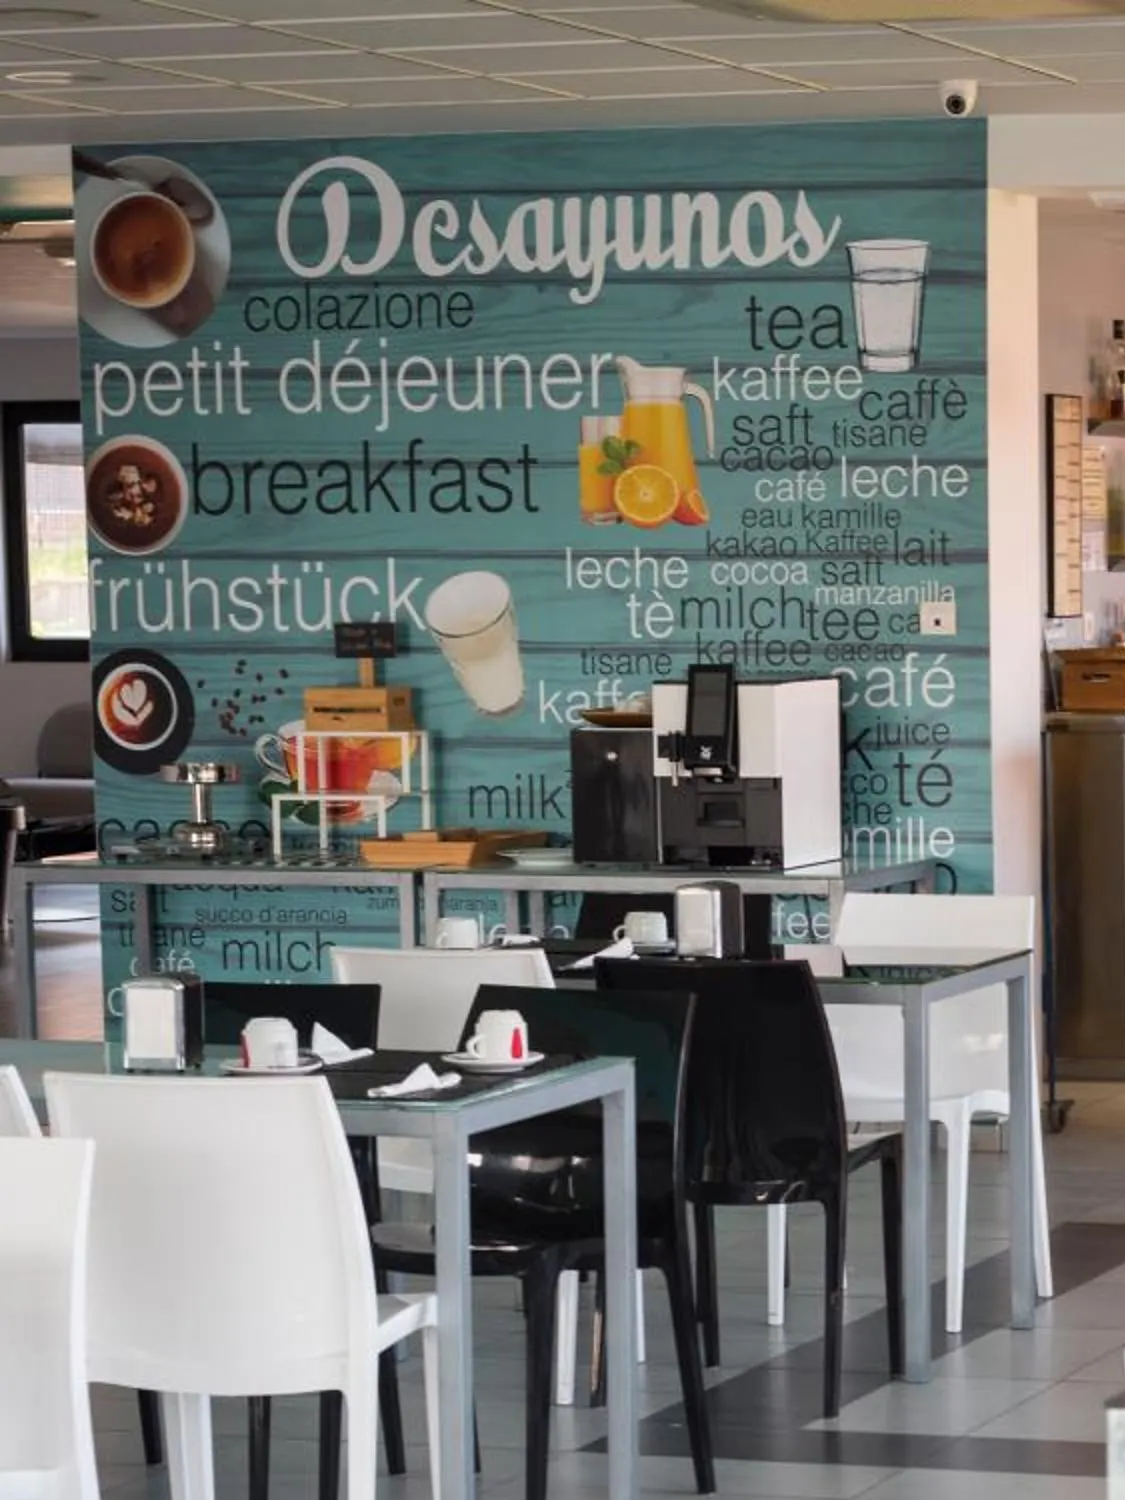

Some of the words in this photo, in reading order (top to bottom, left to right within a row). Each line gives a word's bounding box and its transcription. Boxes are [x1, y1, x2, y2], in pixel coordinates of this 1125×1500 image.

[277, 156, 842, 305] Desayunos
[243, 283, 474, 334] colazione
[745, 296, 849, 351] tea
[93, 340, 252, 435] petit
[278, 337, 613, 433] déjeuner
[713, 353, 864, 401] kaffee
[858, 378, 968, 422] caffè
[732, 403, 814, 447] saft
[832, 418, 928, 449] tisane
[191, 438, 540, 516] breakfast
[720, 444, 835, 473] cacao
[840, 453, 969, 499] leche
[754, 470, 827, 502] café
[740, 507, 794, 530] eau
[801, 502, 902, 530] kamille
[565, 545, 689, 590] leche
[706, 530, 798, 559] kakao
[893, 528, 952, 567] lait
[820, 552, 885, 587] saft
[89, 557, 428, 632] frühstück
[710, 561, 810, 586] cocoa
[814, 580, 956, 605] manzanilla
[625, 589, 675, 640] tè
[680, 585, 805, 630] milch
[805, 600, 880, 642] tee
[579, 646, 673, 676] tisane
[696, 629, 812, 667] kaffee
[823, 642, 906, 663] cacao
[538, 679, 647, 725] kaff
[875, 716, 950, 748] juice
[468, 772, 567, 820] milk
[892, 747, 953, 808] té
[195, 907, 253, 924] succo
